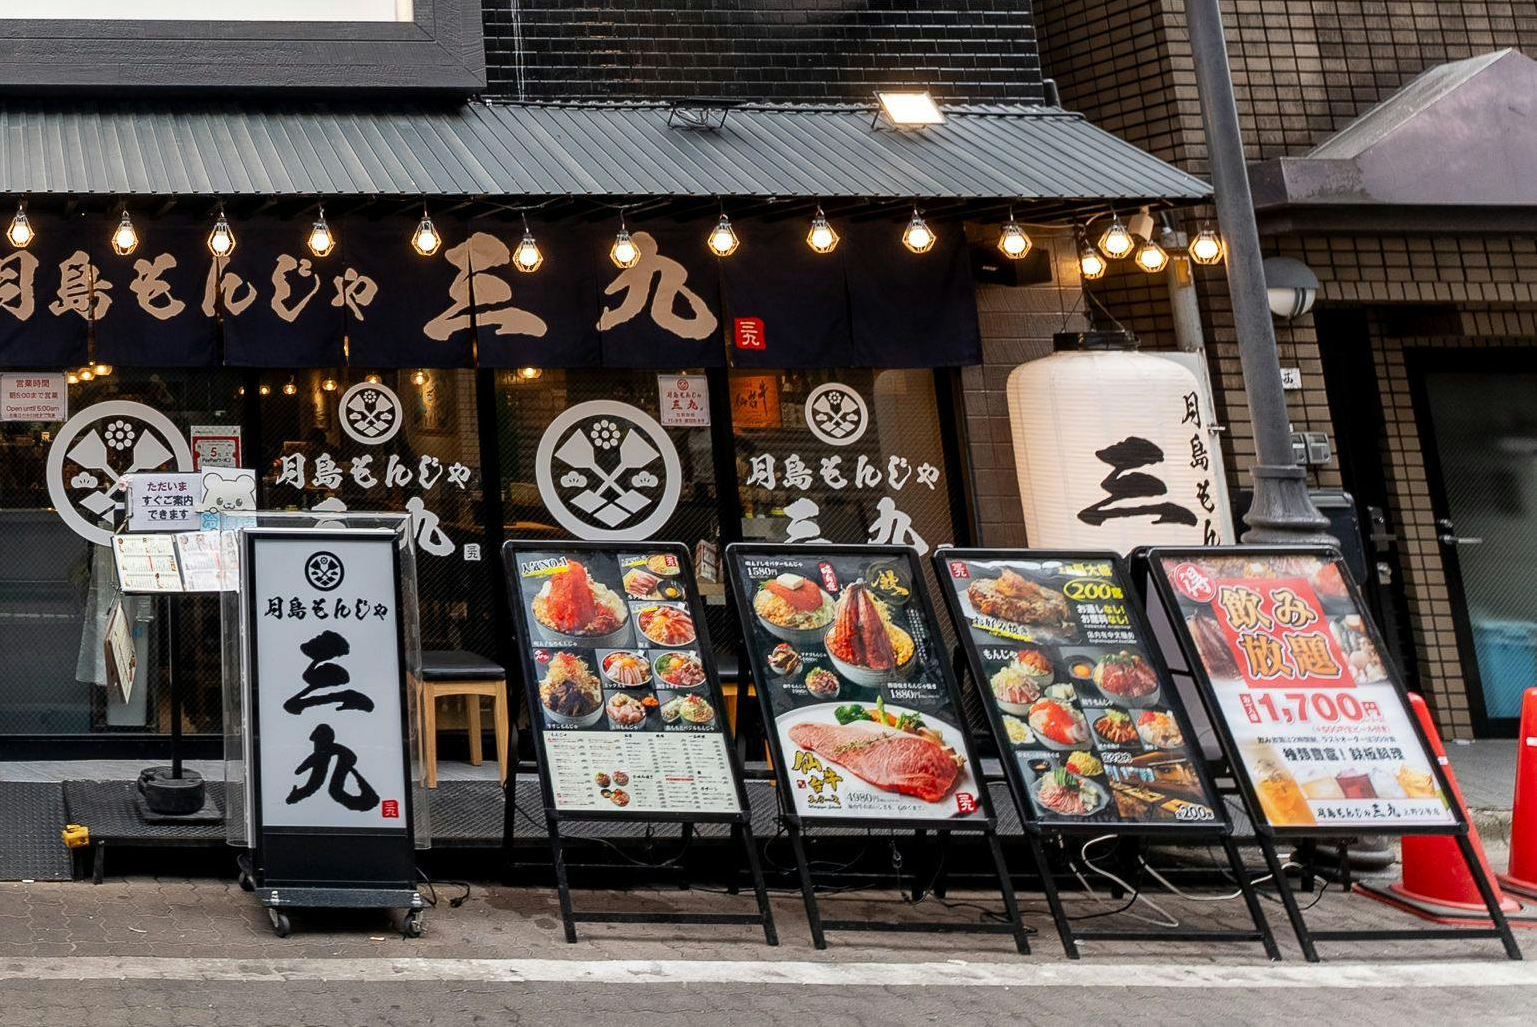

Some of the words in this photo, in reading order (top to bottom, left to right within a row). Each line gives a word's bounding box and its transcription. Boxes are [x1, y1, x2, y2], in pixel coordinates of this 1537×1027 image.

[424, 231, 717, 341] 三九
[740, 320, 761, 348] 三九
[6, 405, 22, 413] Open
[147, 481, 187, 491] ただいま
[1076, 436, 1198, 526] 三
[142, 495, 194, 506] すぐご案内
[148, 510, 189, 520] できます
[1220, 587, 1316, 630] 飲み
[1240, 634, 1340, 678] 放題
[283, 630, 380, 812] 三九
[1258, 693, 1381, 722] 1,700円
[1372, 803, 1401, 818] 三九
